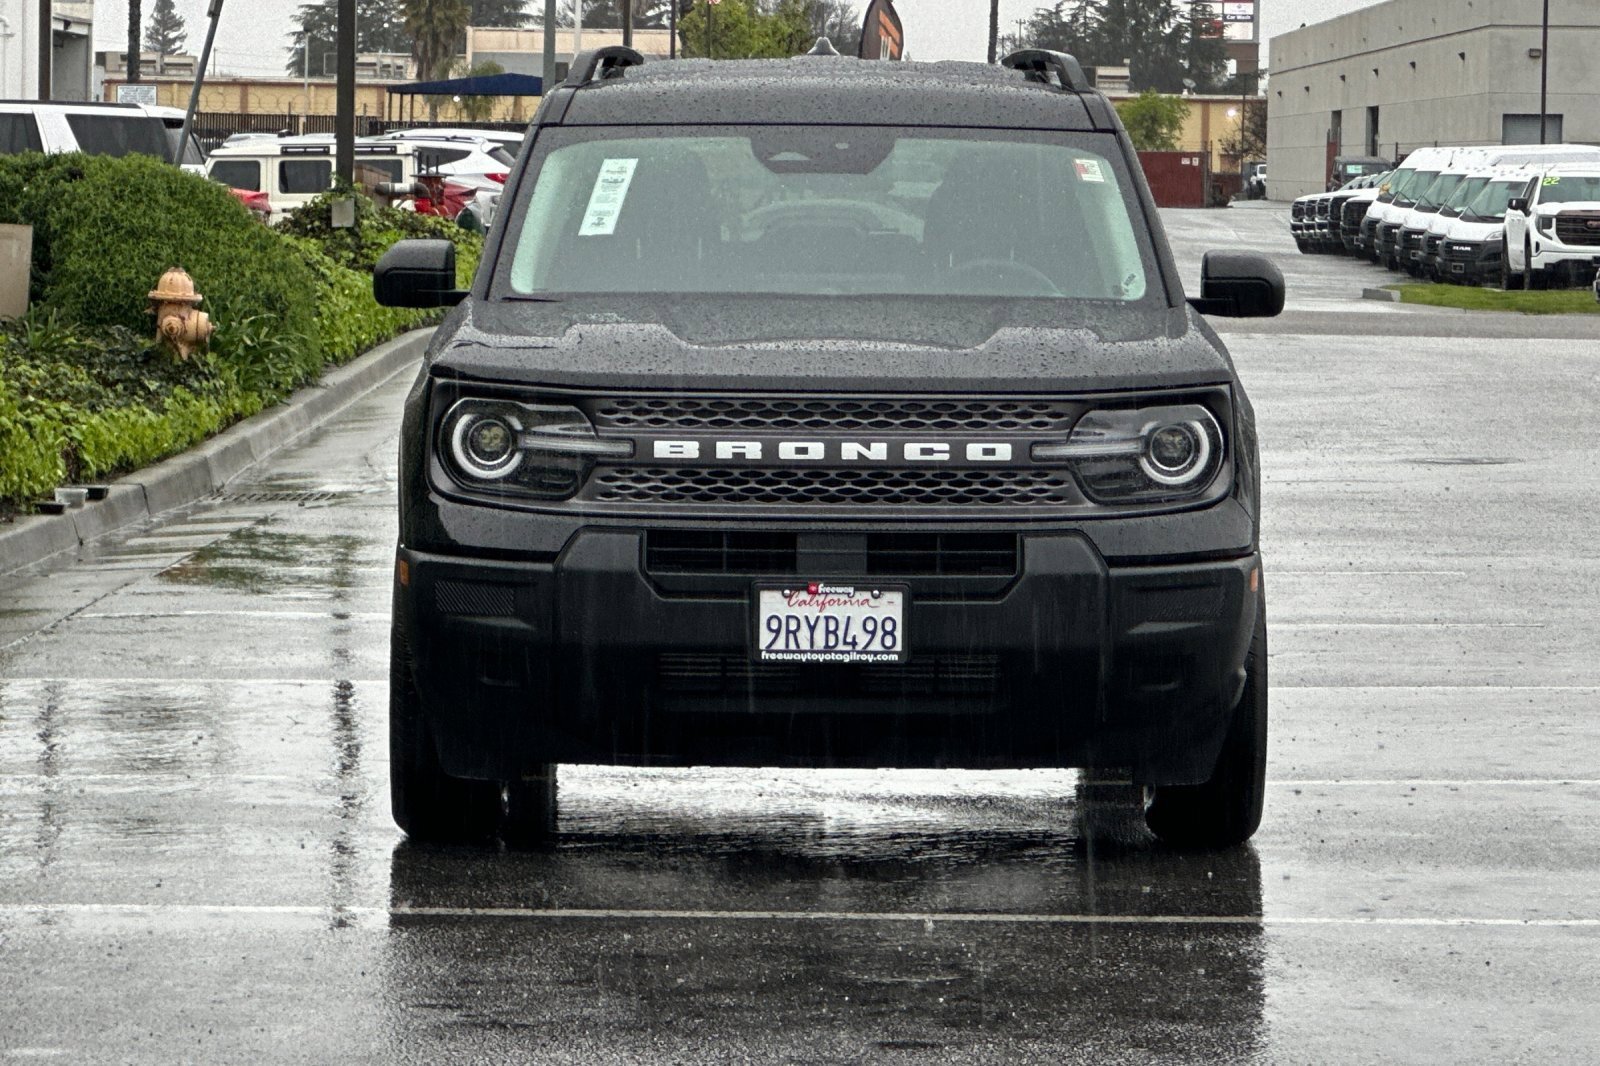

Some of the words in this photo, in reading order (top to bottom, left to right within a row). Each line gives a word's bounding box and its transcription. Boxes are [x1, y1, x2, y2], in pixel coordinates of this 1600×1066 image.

[1543, 177, 1560, 186] 22
[653, 440, 1012, 461] BRONCO
[818, 583, 855, 595] freeway
[787, 591, 880, 613] California
[765, 614, 897, 650] 9RYB498
[761, 651, 898, 663] freewaytoyotagilroy.com
